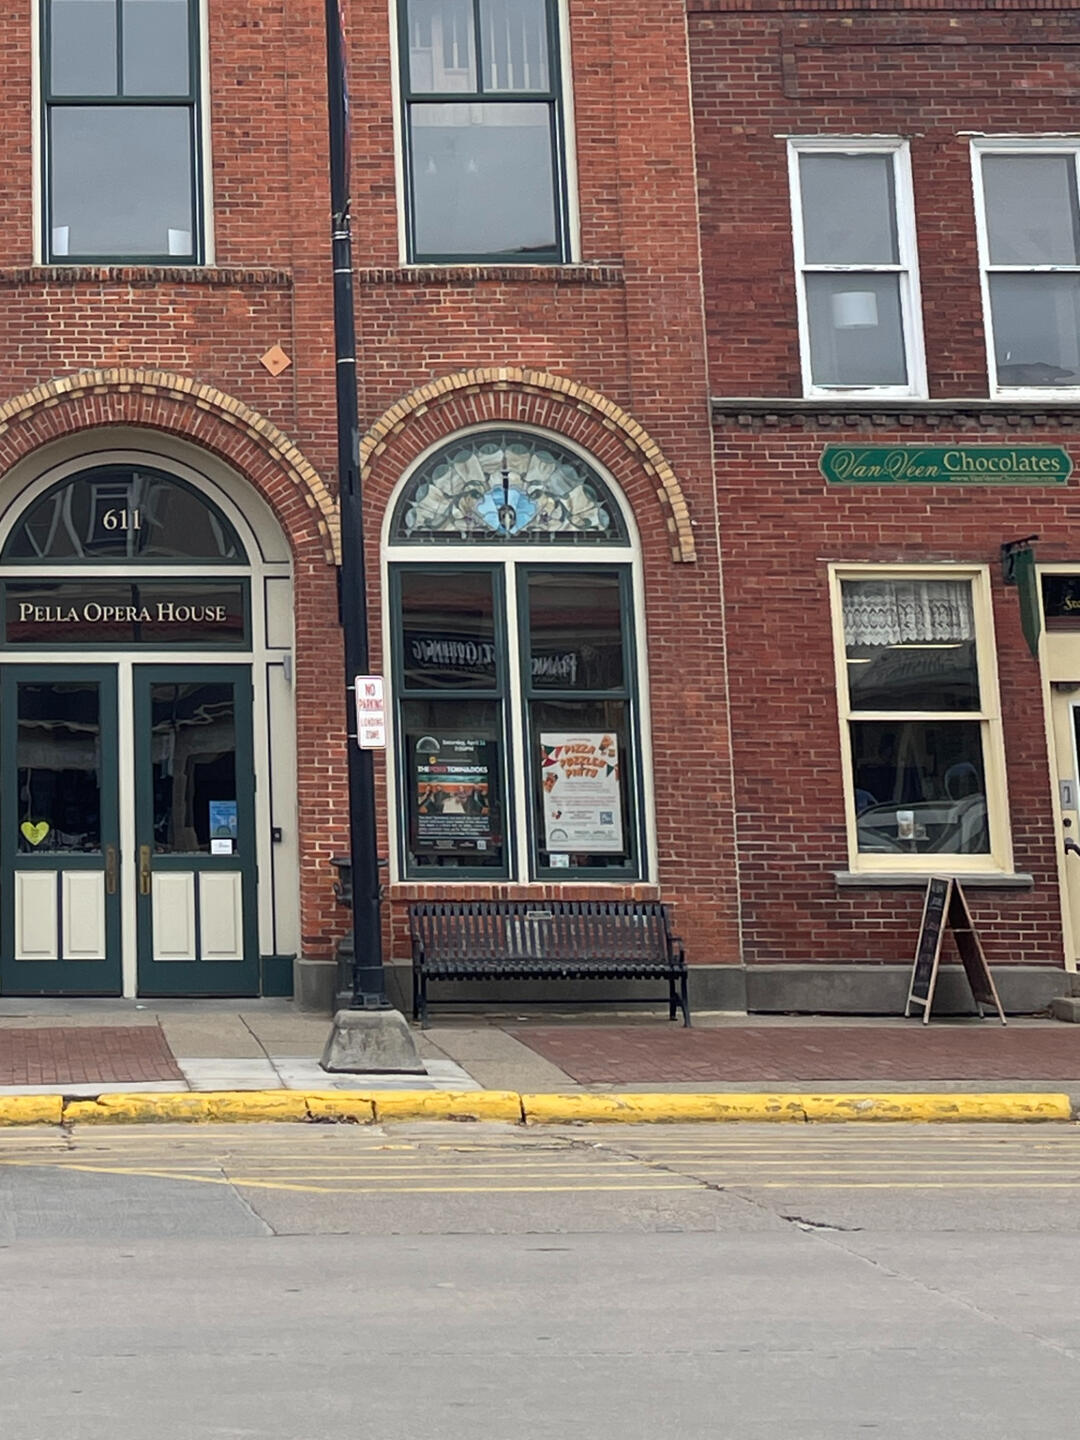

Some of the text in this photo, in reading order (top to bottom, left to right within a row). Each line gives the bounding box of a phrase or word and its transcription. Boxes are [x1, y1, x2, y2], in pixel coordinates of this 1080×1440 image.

[942, 451, 1061, 472] Chocolates
[102, 509, 142, 530] 611
[19, 602, 227, 622] PELLA OPERA HOUSE
[364, 682, 376, 697] NO
[358, 699, 383, 709] PARKING
[564, 744, 596, 754] PIZZA
